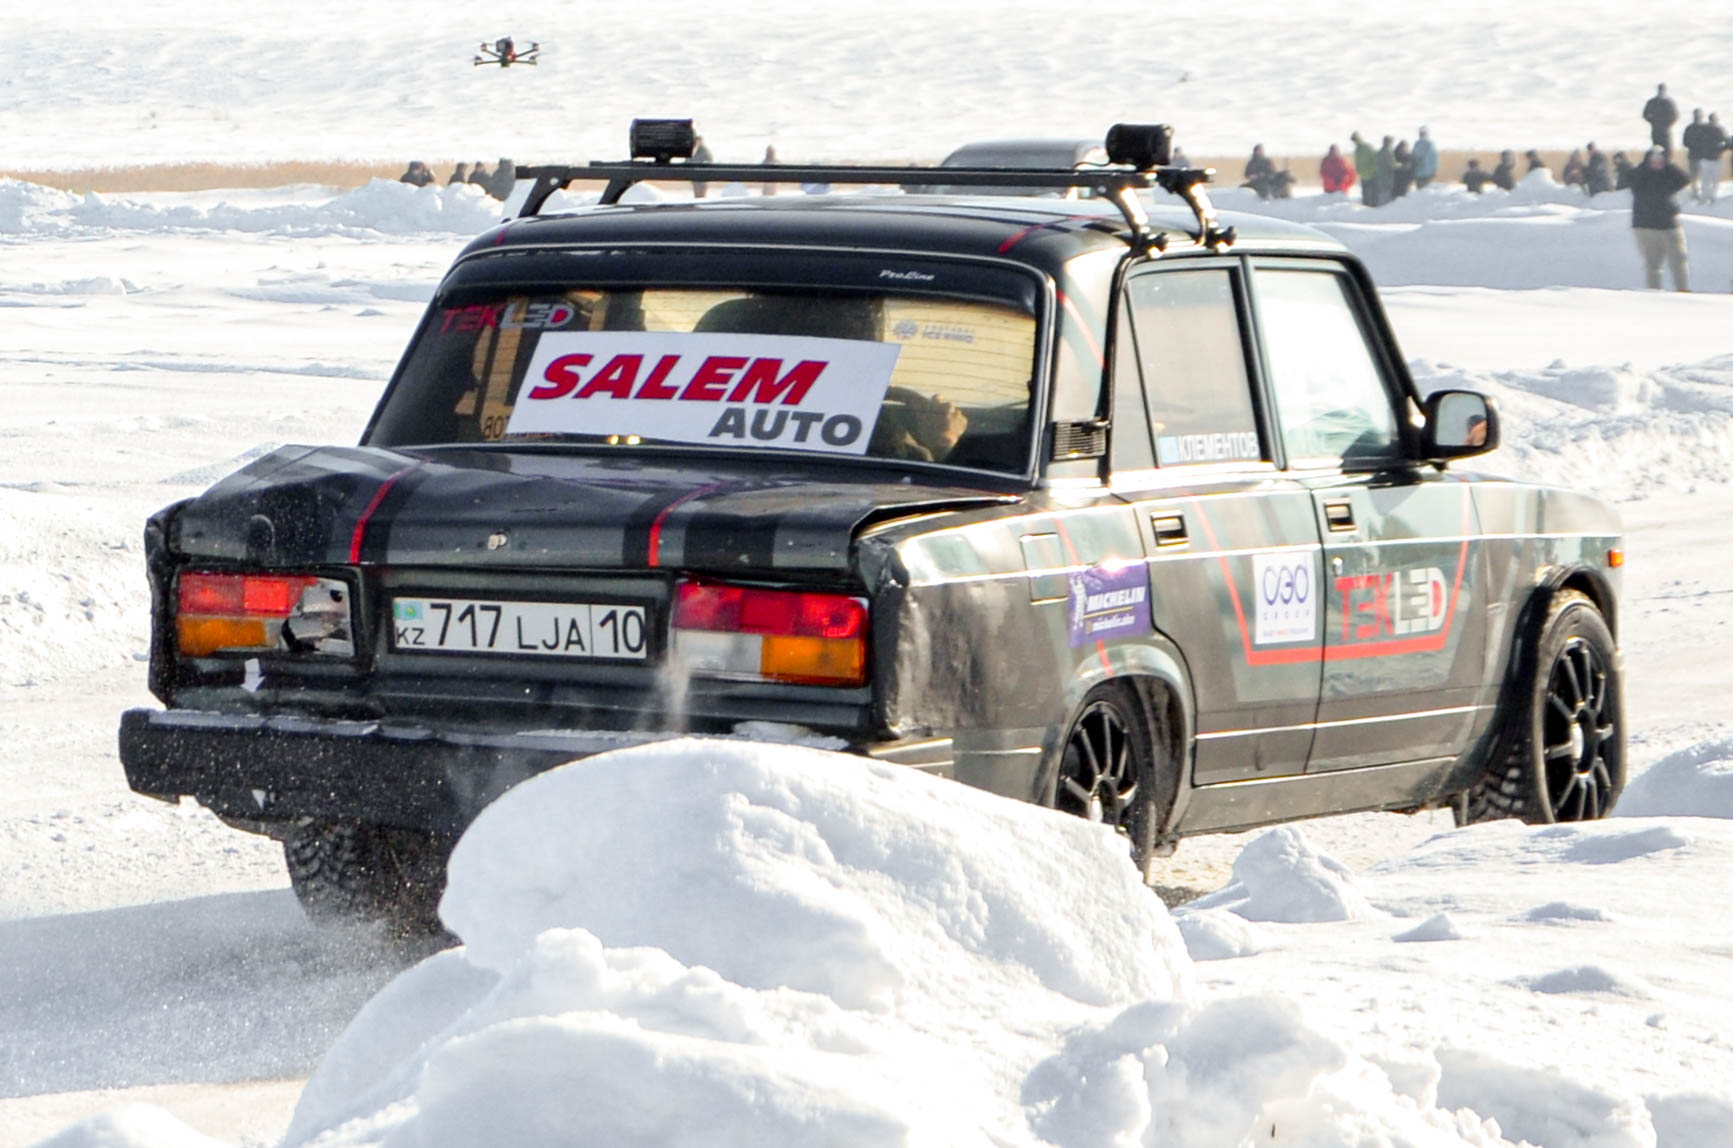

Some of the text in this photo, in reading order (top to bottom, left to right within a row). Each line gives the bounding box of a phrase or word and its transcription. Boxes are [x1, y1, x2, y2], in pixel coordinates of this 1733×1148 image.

[528, 353, 829, 405] SALEM
[708, 407, 863, 446] AUTO
[1086, 586, 1146, 612] MICHELIN
[396, 603, 646, 654] KZ 717 LJA 10
